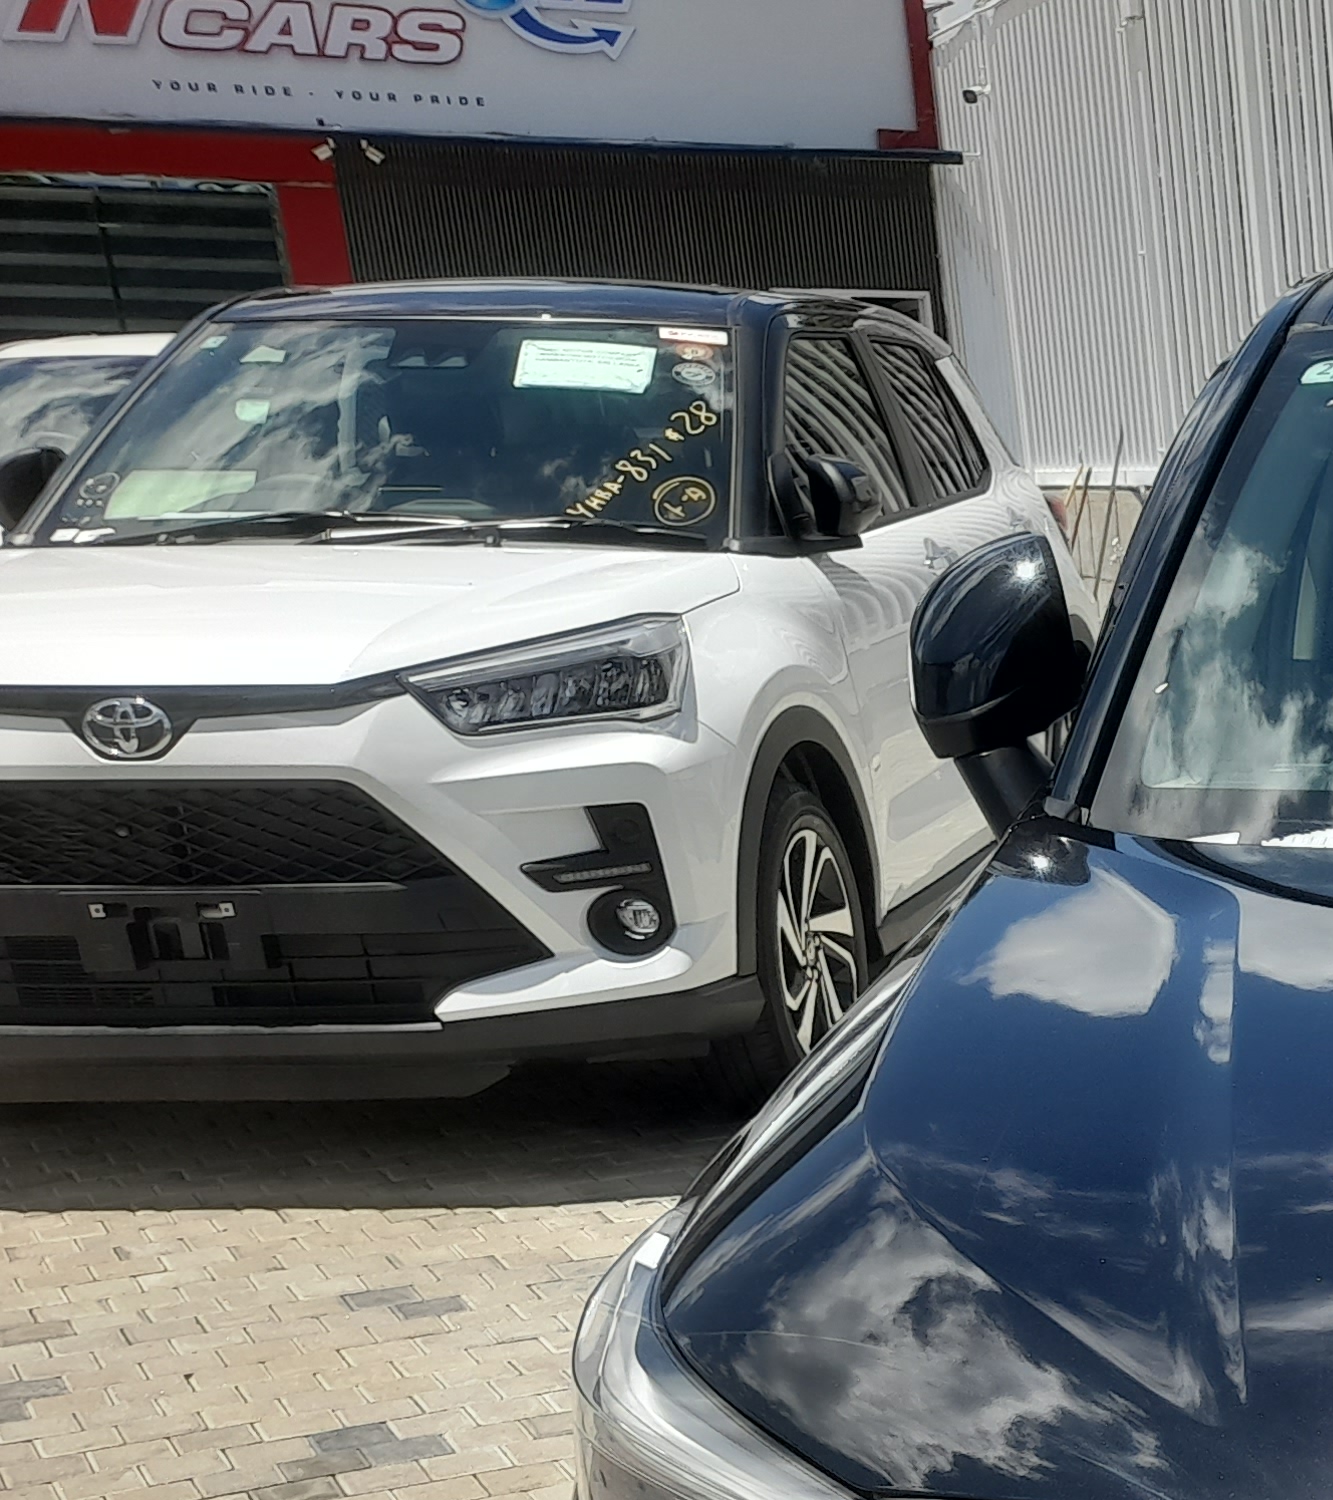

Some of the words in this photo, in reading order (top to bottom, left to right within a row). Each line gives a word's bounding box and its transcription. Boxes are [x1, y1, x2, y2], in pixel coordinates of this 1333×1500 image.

[158, 0, 468, 65] CARS
[152, 79, 218, 93] YOUR
[234, 84, 293, 97] RIDE
[336, 90, 397, 102] YOUR
[414, 94, 485, 107] PRIDE
